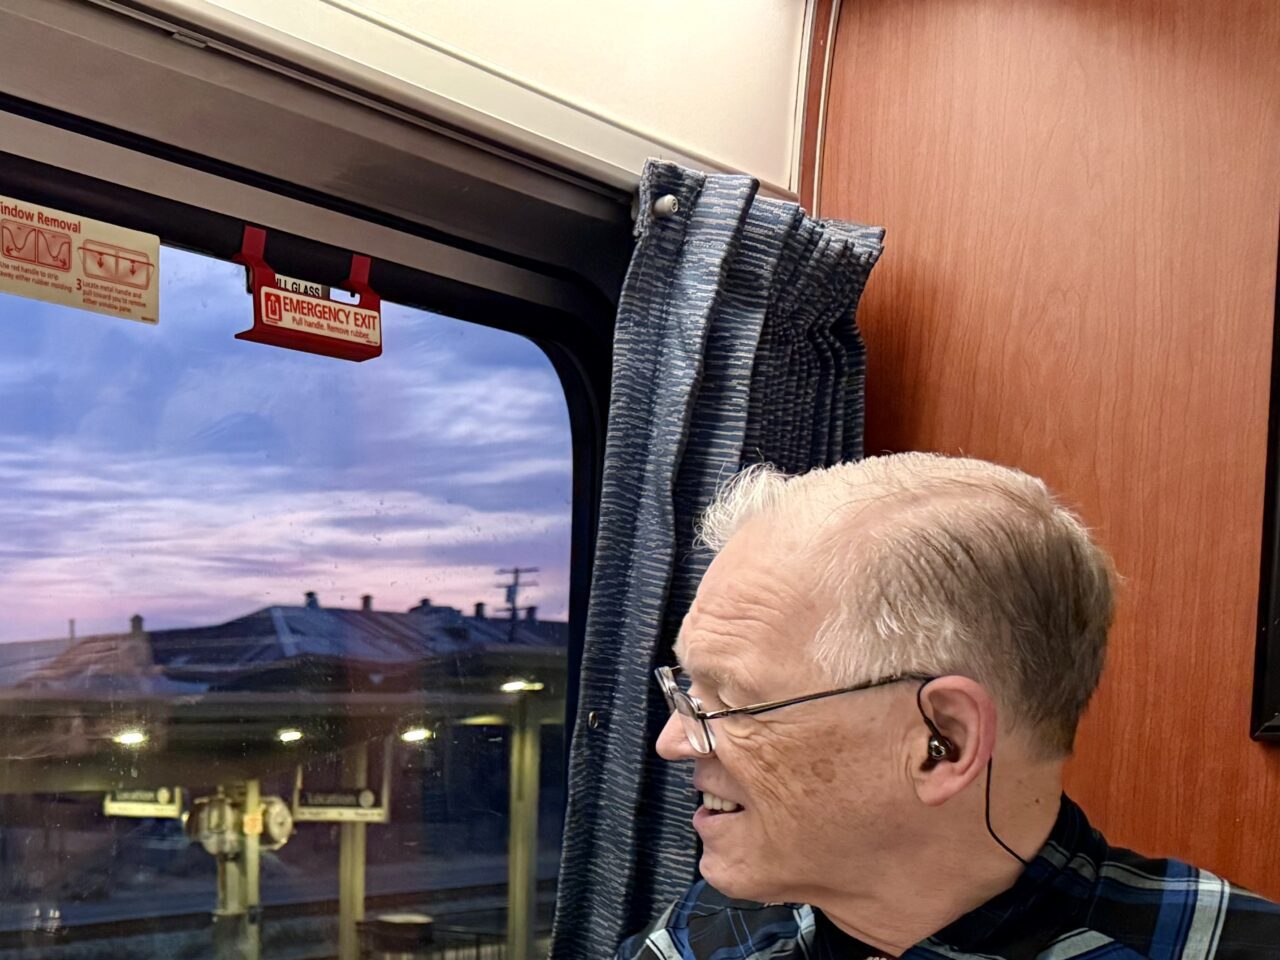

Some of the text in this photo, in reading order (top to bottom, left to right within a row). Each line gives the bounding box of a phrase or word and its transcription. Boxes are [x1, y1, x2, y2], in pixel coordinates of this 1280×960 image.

[36, 211, 81, 234] Removal
[0, 261, 10, 269] Use
[11, 264, 20, 272] red
[21, 266, 39, 276] handle
[76, 278, 82, 290] 3
[291, 282, 320, 297] GLASS
[283, 296, 377, 330] EMERGENCY EXIT
[292, 315, 302, 325] Pull
[327, 323, 349, 336] Remove
